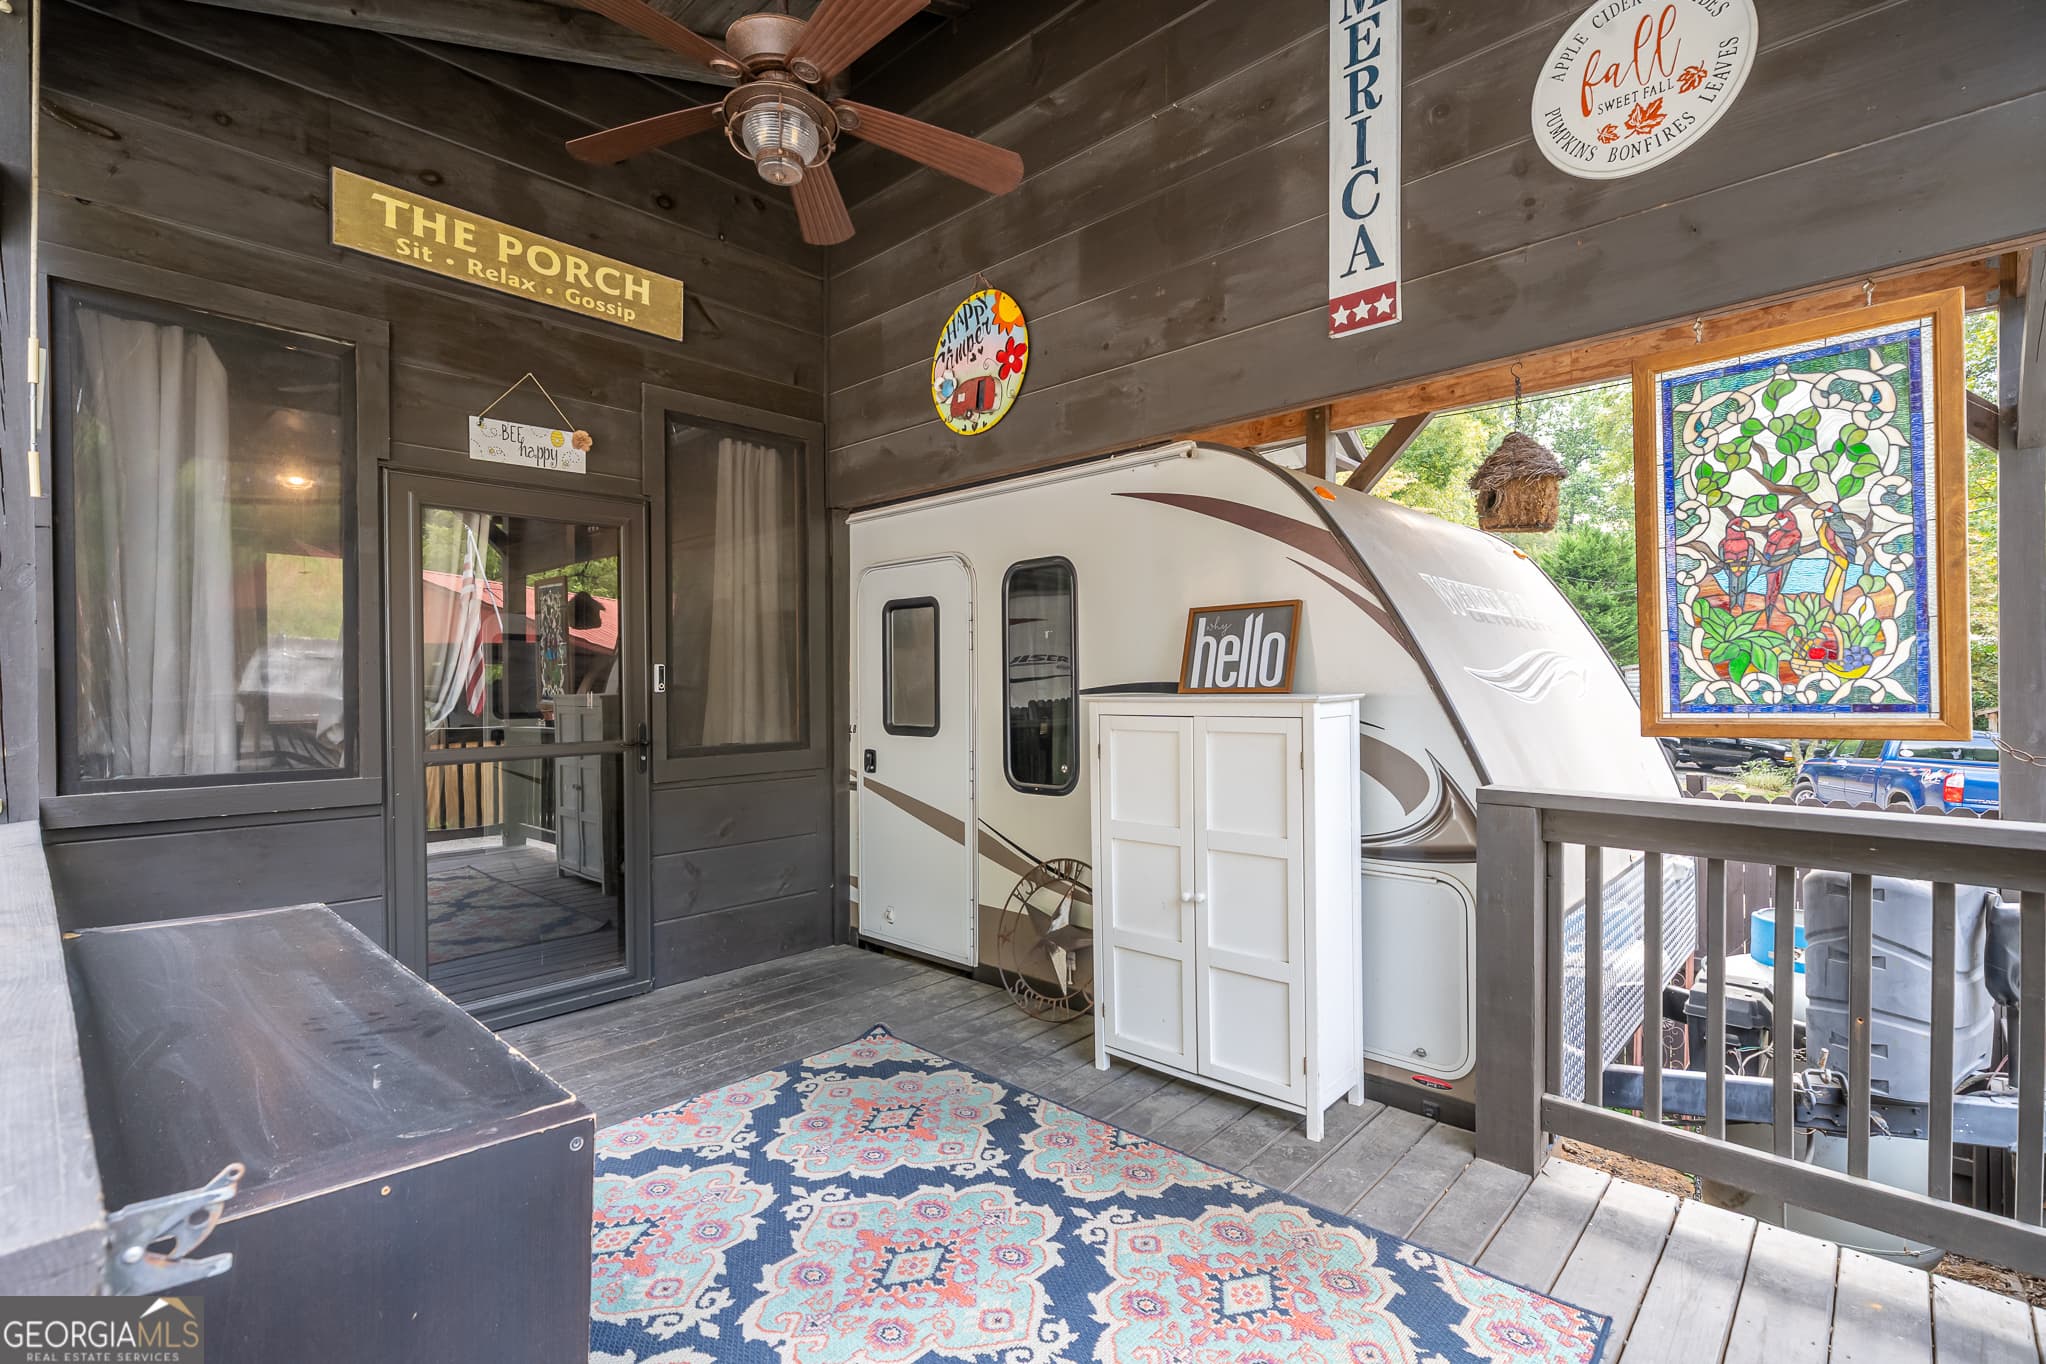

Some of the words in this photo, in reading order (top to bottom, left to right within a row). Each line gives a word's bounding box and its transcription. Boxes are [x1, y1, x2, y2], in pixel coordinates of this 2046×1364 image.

[1551, 33, 1589, 82] APPLE
[1581, 4, 1682, 117] fall
[1544, 106, 1598, 162] PUMPKINS
[1607, 111, 1696, 163] BONFIRES
[1698, 35, 1740, 103] LEAVES
[1597, 91, 1637, 115] SWEET
[1643, 78, 1675, 99] FALL
[371, 192, 478, 254] THE
[497, 232, 653, 306] PORCH
[396, 238, 433, 264] Sit
[467, 258, 536, 293] Relax
[565, 288, 637, 323] Gossip
[502, 423, 524, 443] BEE
[519, 436, 558, 469] happy
[1190, 612, 1286, 689] hello
[1206, 615, 1232, 637] why
